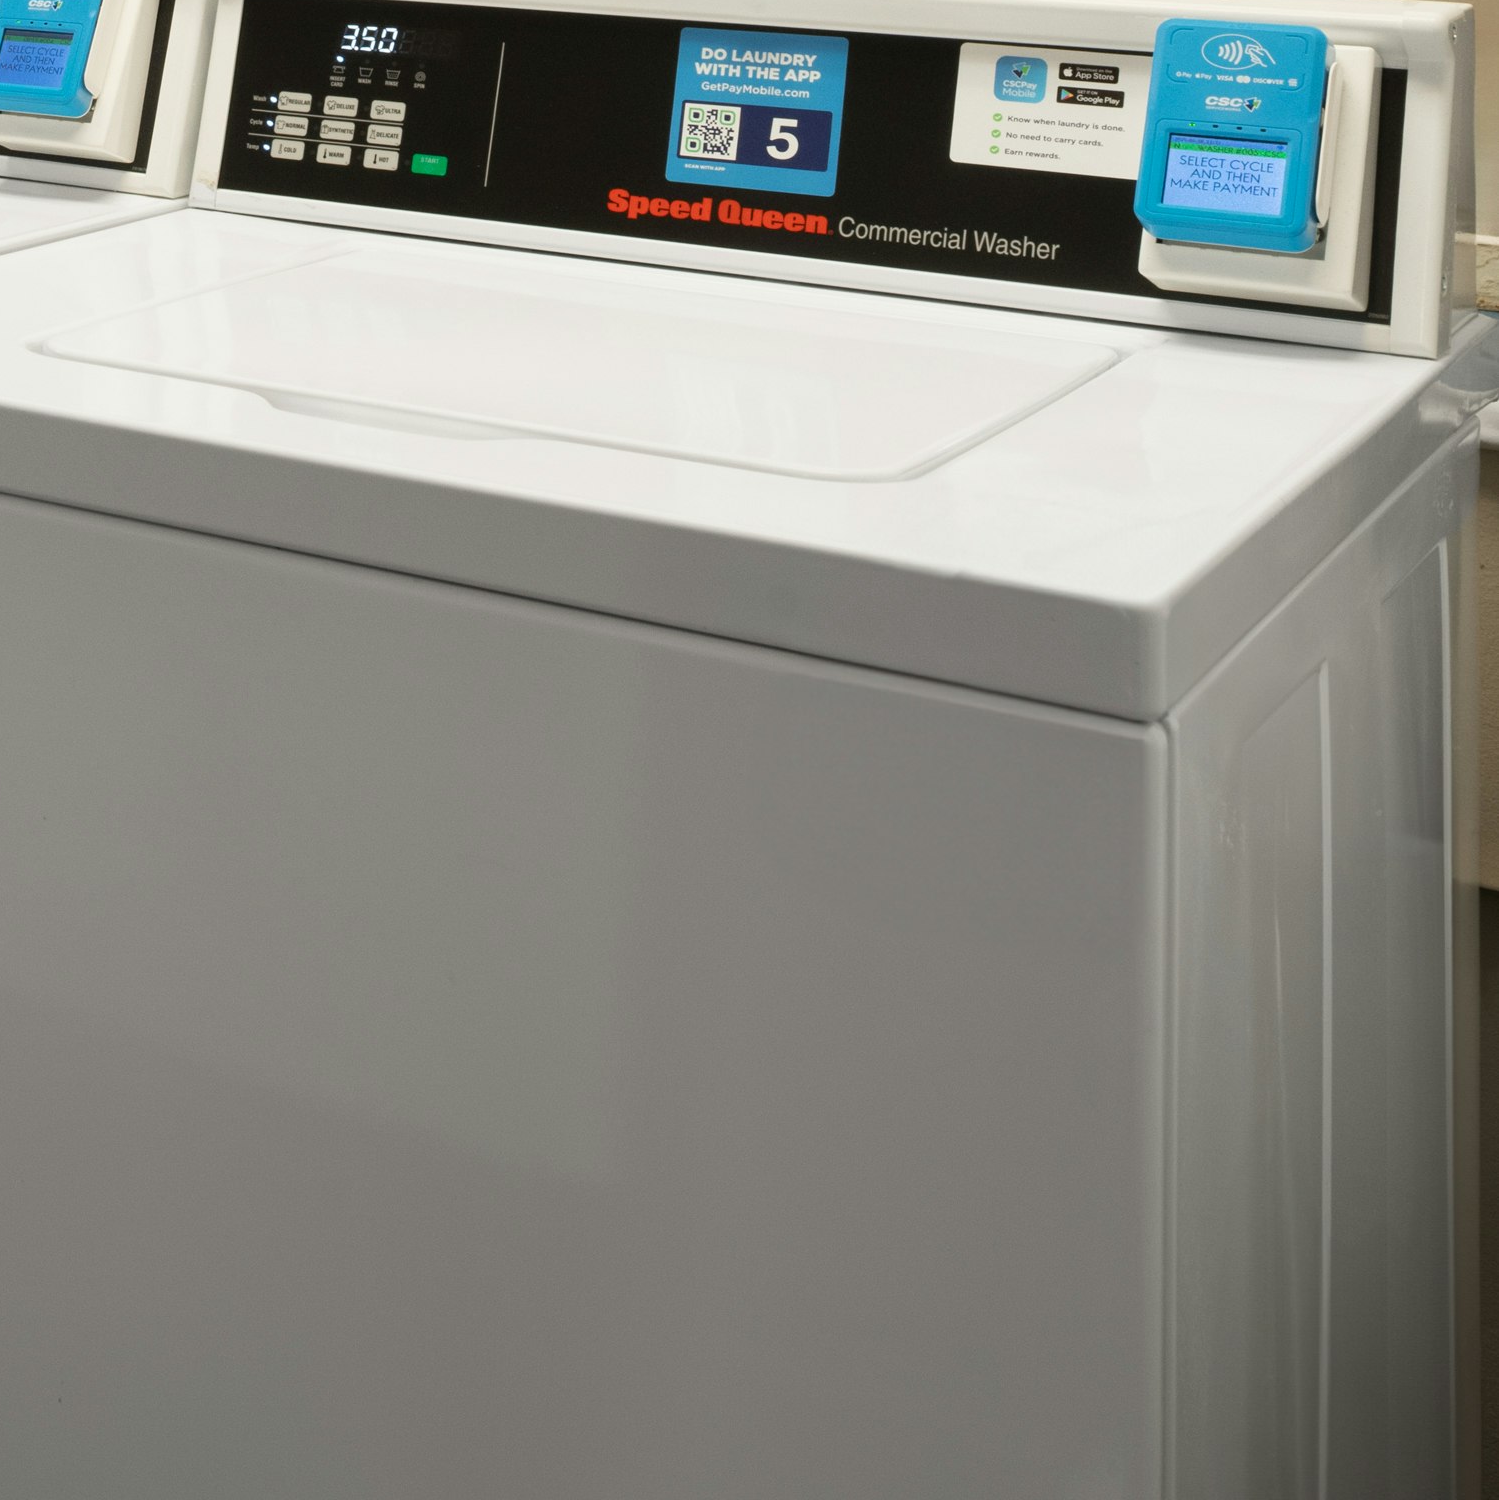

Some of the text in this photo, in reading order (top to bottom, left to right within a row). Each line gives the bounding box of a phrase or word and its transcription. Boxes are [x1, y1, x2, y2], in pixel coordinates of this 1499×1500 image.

[341, 25, 398, 53] 3.50
[8, 45, 65, 57] SELECT CYCLE
[701, 47, 817, 67] DO LAUNDRY
[13, 55, 55, 65] AND THEN
[1, 63, 64, 75] MAKE PAYMENT
[695, 62, 821, 84] WITH THE APP
[1075, 71, 1115, 81] App Store
[1216, 74, 1234, 82] VISA
[1253, 77, 1284, 85] DISCOVER
[701, 81, 810, 98] GetPayMobile.com
[1003, 80, 1037, 90] CSCPay
[1002, 89, 1037, 98] Mobile
[1076, 94, 1120, 106] Google Play
[1205, 96, 1244, 107] CSC
[285, 122, 306, 130] NORMAL
[1007, 115, 1030, 123] Know
[1034, 118, 1056, 126] when
[1058, 120, 1089, 130] laundry
[1101, 124, 1126, 132] done.
[328, 127, 354, 135] SYNTHETIC
[376, 131, 399, 140] DELICATE
[766, 117, 799, 160] 5
[1020, 134, 1041, 142] need
[1055, 137, 1076, 145] carry
[1078, 139, 1103, 147] cards.
[1004, 148, 1061, 159] Earn rewards.
[1179, 155, 1274, 173] SELECT CYCLE
[1190, 168, 1261, 184] AND THEN
[1170, 178, 1278, 197] MAKE PAYMENT
[607, 188, 1061, 260] Speed Queen Commercial Washer
